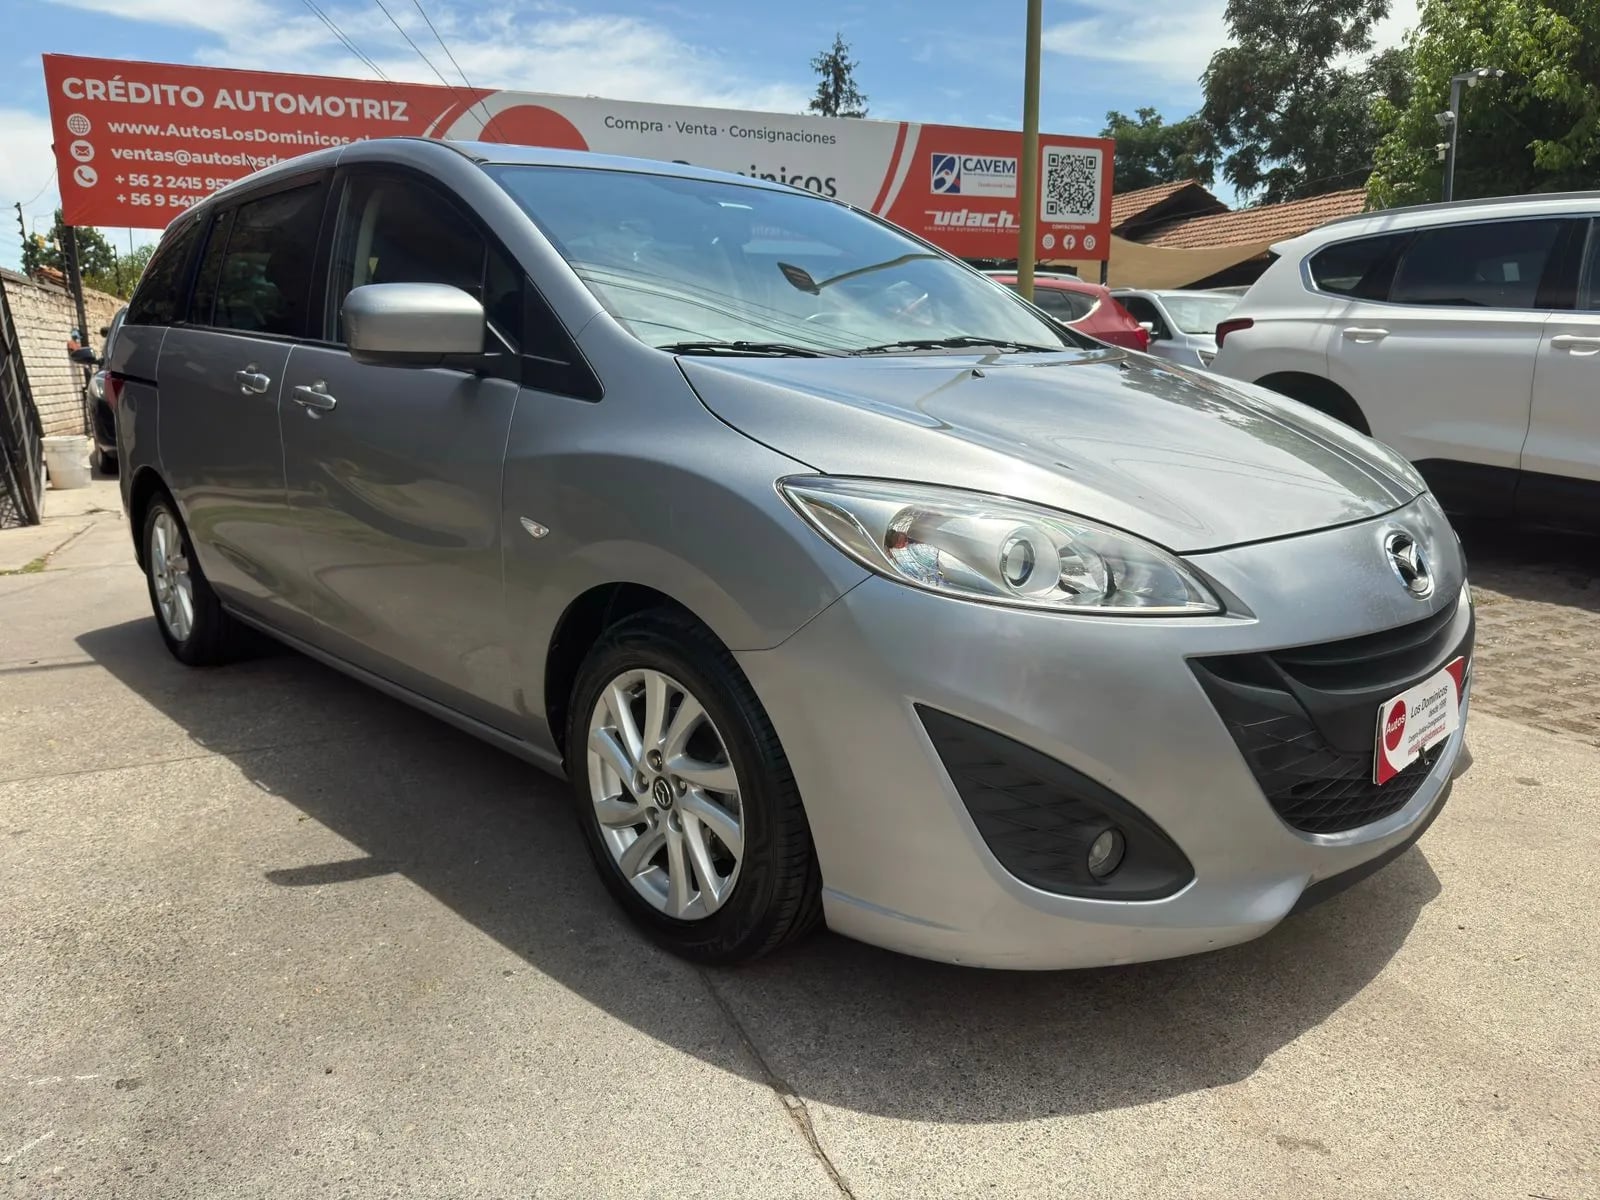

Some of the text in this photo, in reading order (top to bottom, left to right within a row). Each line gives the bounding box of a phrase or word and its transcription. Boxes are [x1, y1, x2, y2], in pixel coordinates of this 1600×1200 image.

[62, 74, 410, 122] CRÉDITO AUTOMOTRIZ
[604, 115, 837, 145] Compra Venta Consignaciones
[111, 148, 286, 168] ventas@autoslosd
[962, 157, 1016, 174] CAVEM
[129, 173, 150, 187] 56
[152, 174, 164, 188] 2
[166, 175, 203, 190] 2415
[130, 192, 152, 206] 56
[154, 194, 166, 207] 9
[1410, 685, 1448, 719] Los Dominicos
[1386, 713, 1406, 736] Autos
